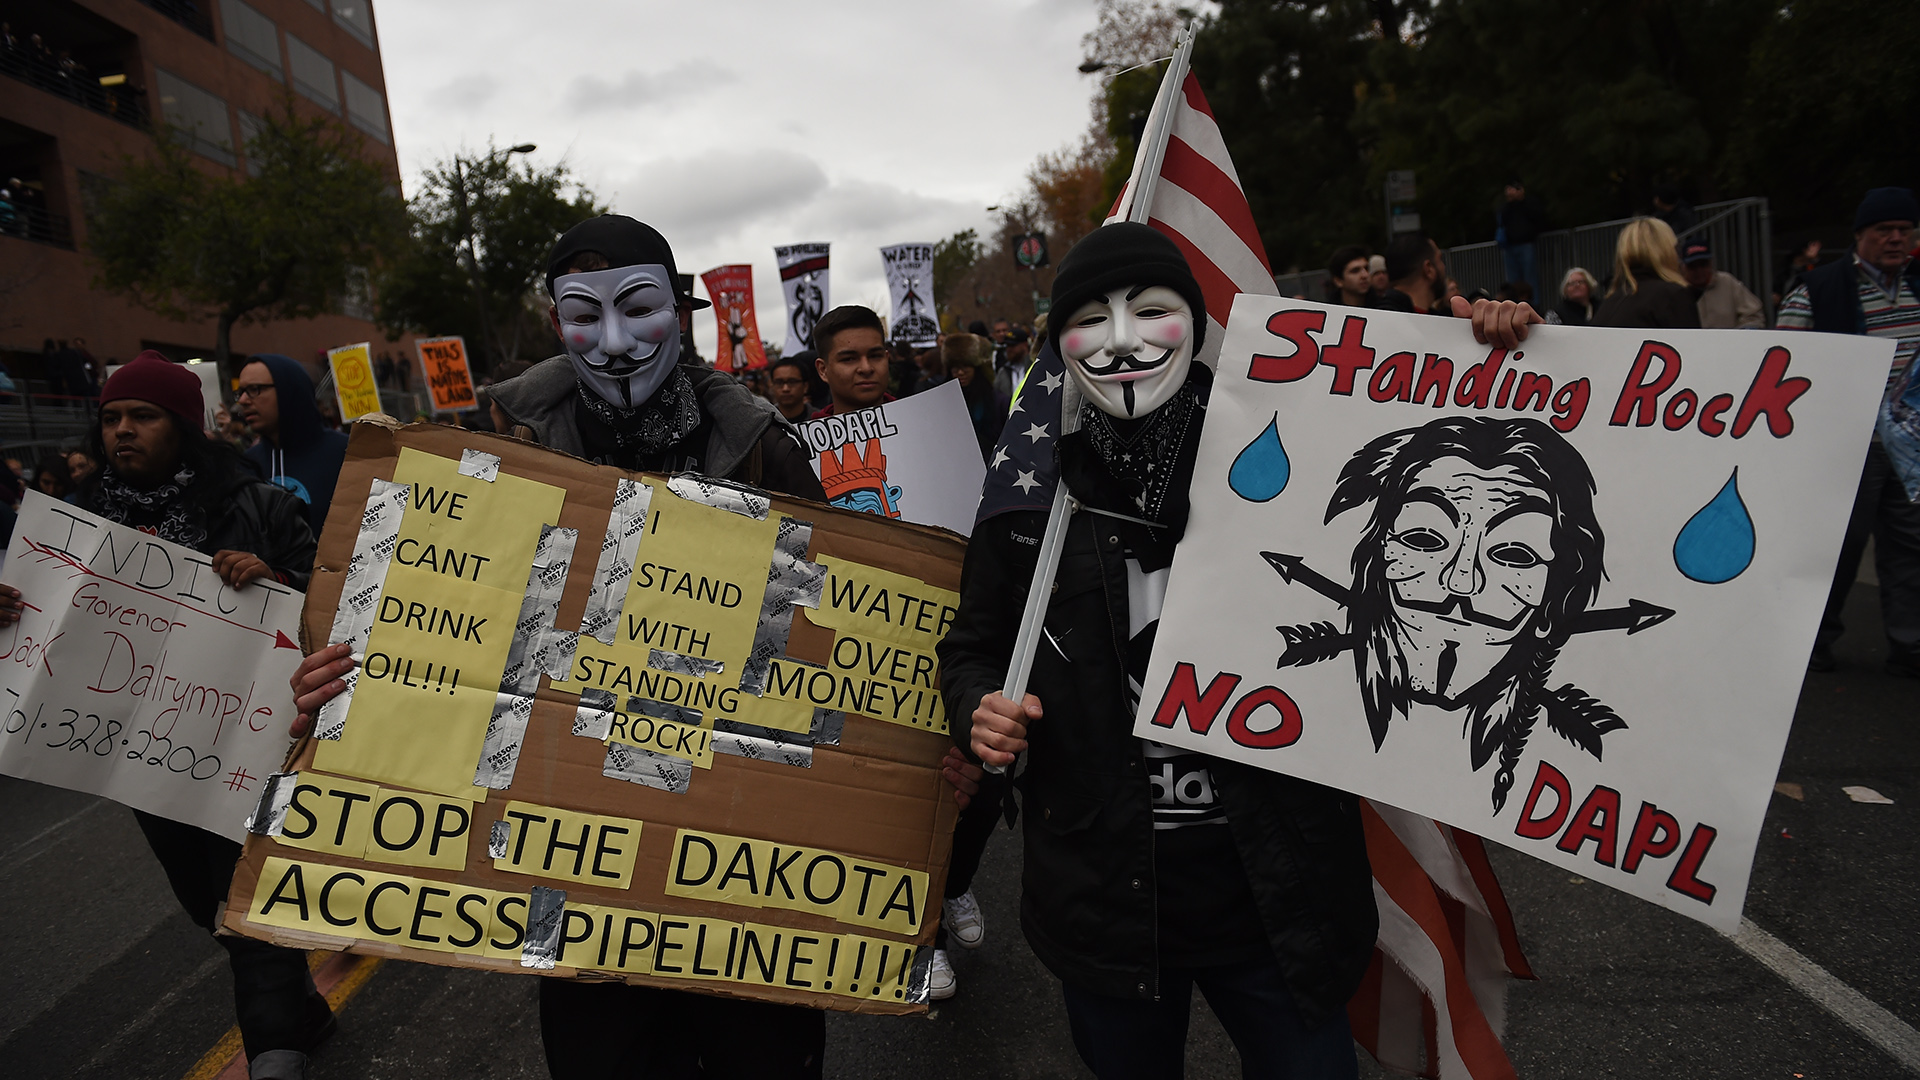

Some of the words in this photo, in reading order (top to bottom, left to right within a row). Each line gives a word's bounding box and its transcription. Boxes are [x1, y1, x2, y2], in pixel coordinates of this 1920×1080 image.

[883, 246, 931, 263] WATER
[422, 343, 460, 362] THIS
[437, 359, 451, 373] IS
[1247, 309, 1592, 432] Standing
[1609, 339, 1812, 439] Rock
[430, 369, 467, 389] NATIVE
[435, 387, 474, 405] LAND
[414, 482, 468, 520] WE
[740, 492, 759, 519] FASSON
[749, 497, 761, 511] 957
[630, 516, 643, 528] 957
[651, 510, 660, 535] I
[38, 508, 291, 624] INDICT
[395, 538, 490, 582] CANT
[538, 559, 567, 579] FASSON
[547, 570, 561, 582] 957
[604, 567, 632, 588] FASSON
[609, 565, 623, 577] 957
[348, 583, 379, 604] FASSON
[636, 562, 742, 608] STAND
[72, 583, 187, 633] Govenor
[358, 594, 373, 607] 957
[379, 595, 488, 645] DRINK
[516, 610, 545, 630] FASSON
[526, 621, 540, 633] 957
[582, 617, 612, 635] FASSON
[565, 638, 579, 650] 957
[628, 614, 711, 657] WITH
[0, 601, 66, 677] Jack
[87, 631, 273, 746] Dalrymple
[833, 637, 934, 689] OVER
[365, 652, 460, 696] OIL!!!
[504, 673, 519, 685] 957
[574, 656, 741, 713] STANDING
[519, 702, 533, 715] 957
[1150, 661, 1303, 749] NO
[609, 712, 707, 757] ROCK!
[487, 742, 518, 764] FASSON
[497, 753, 512, 767] 957
[615, 749, 626, 763] 957
[745, 743, 757, 756] 957
[655, 763, 676, 792] FASSON
[665, 769, 680, 784] 957
[1514, 759, 1717, 906] DAPL
[281, 784, 469, 857] STOP
[507, 811, 629, 879] THE
[674, 834, 917, 926] DAKOTA
[259, 864, 527, 950] ACCESS
[556, 909, 912, 999] PIPELINE!!!!
